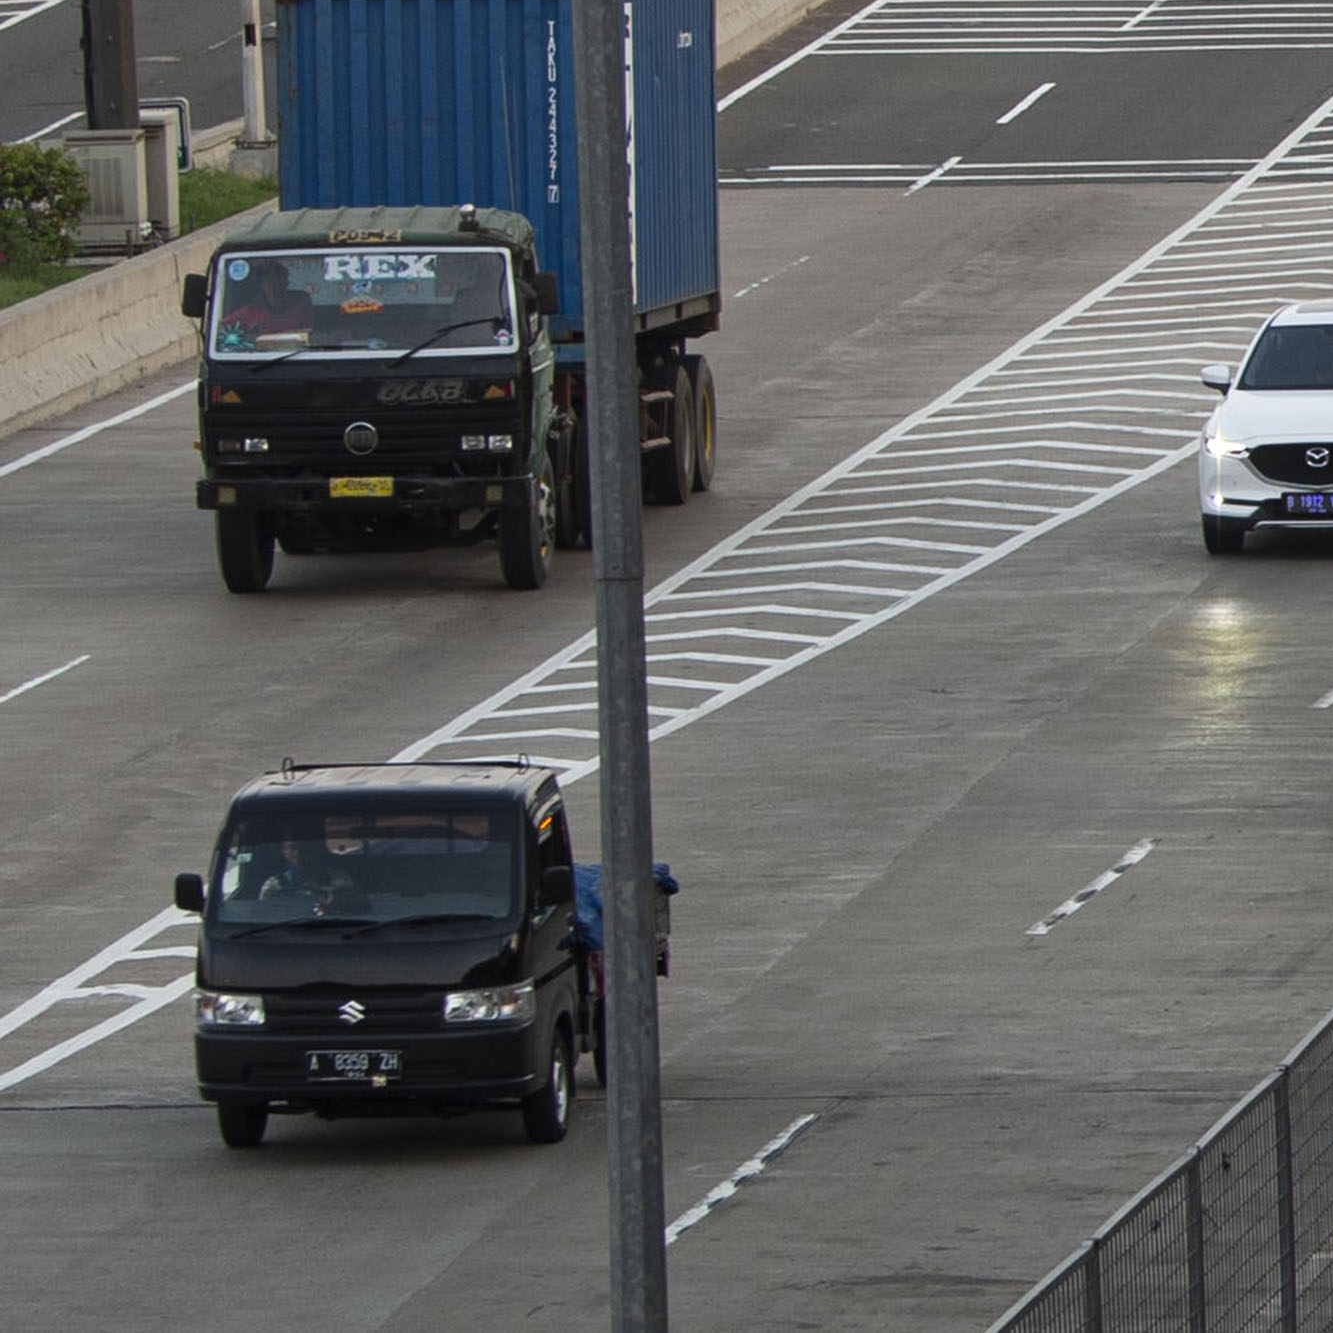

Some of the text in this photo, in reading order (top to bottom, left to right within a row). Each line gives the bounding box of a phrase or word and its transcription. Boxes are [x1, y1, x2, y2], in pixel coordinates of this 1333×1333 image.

[547, 21, 559, 203] TAKU 244327 7
[325, 255, 437, 280] REX
[310, 1054, 319, 1070] A
[380, 1053, 398, 1070] ZH
